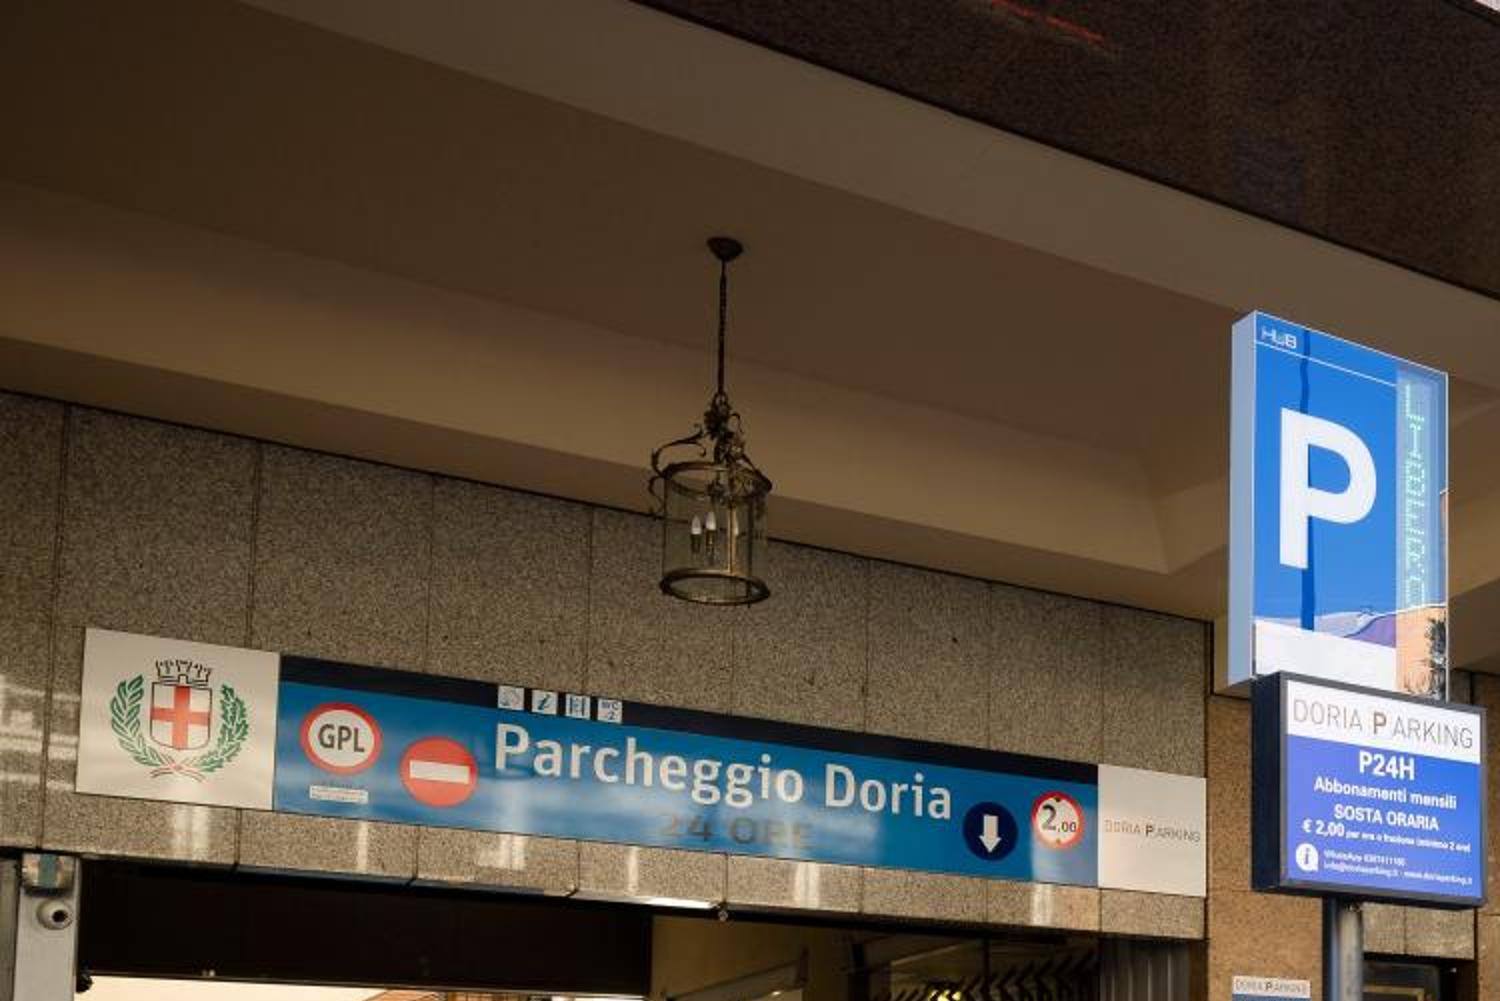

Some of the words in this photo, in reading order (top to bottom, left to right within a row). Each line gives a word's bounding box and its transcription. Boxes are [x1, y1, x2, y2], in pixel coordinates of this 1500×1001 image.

[1280, 407, 1377, 569] P
[318, 724, 365, 752] GPL
[1293, 700, 1362, 731] DORIA
[1373, 711, 1473, 749] PARKING
[495, 723, 804, 808] Parcheggio
[824, 763, 952, 819] Doria
[1359, 750, 1415, 780] P24H
[1313, 776, 1407, 803] Abbonamenti
[1411, 793, 1457, 810] mensili
[658, 813, 711, 842] 24
[728, 816, 813, 848] ORE
[1104, 819, 1141, 834] DORIA
[1145, 824, 1201, 842] PARKING
[1315, 821, 1345, 837] 2,00
[1334, 803, 1382, 824] SOSTA
[1387, 811, 1439, 831] ORARIA
